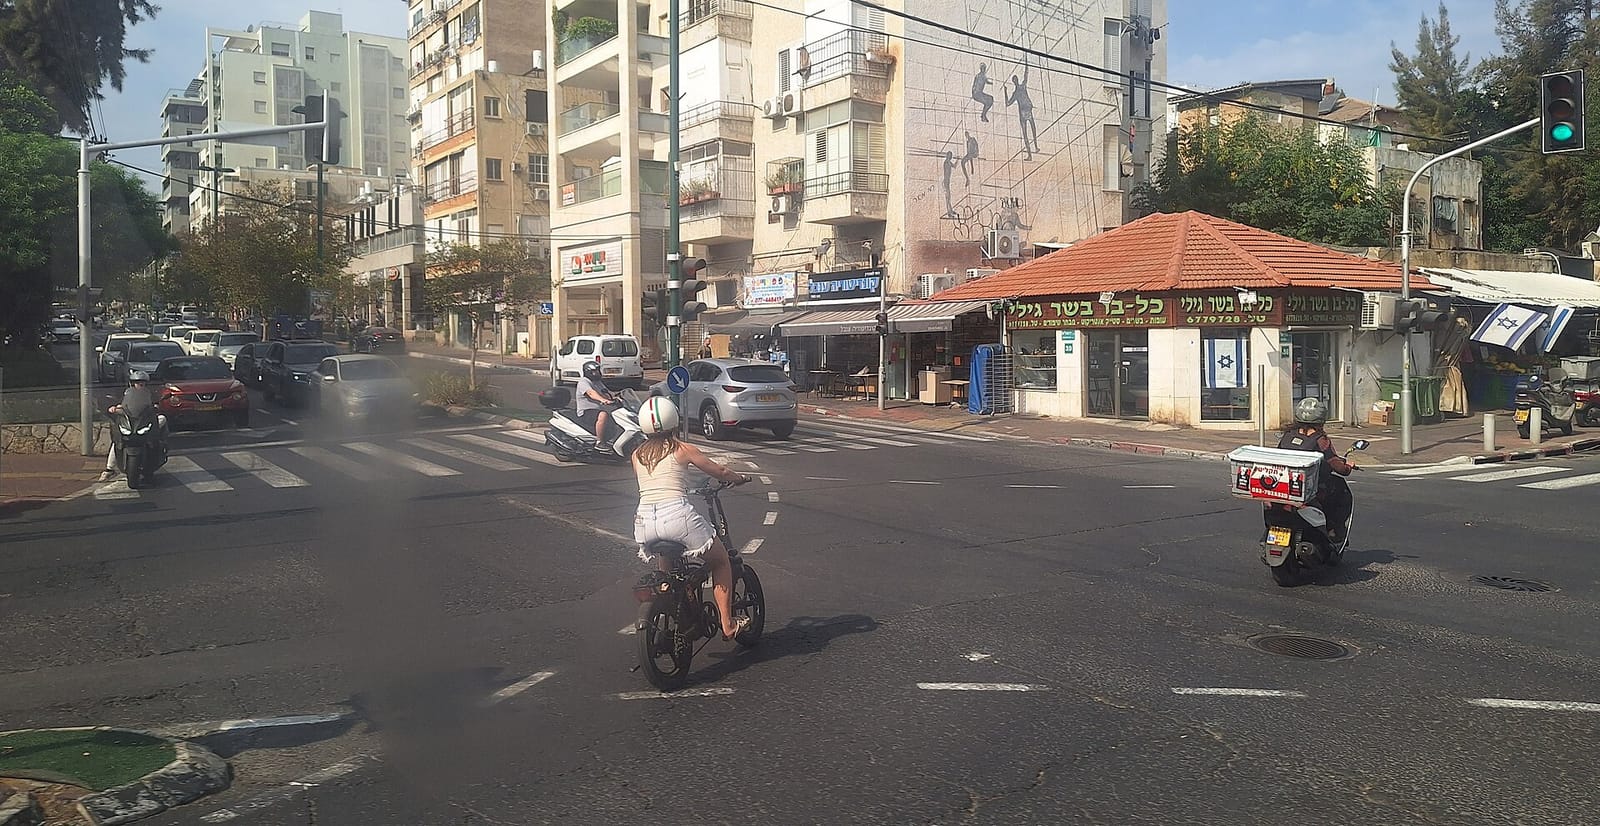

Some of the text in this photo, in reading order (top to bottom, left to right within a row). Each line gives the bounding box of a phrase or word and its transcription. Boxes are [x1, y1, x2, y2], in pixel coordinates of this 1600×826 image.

[1008, 301, 1042, 318] גילי
[1051, 301, 1094, 317] בשר
[1181, 295, 1203, 313] גילי
[1208, 296, 1234, 312] בשר
[1309, 296, 1329, 312] בשר
[1186, 315, 1240, 324] 6779728
